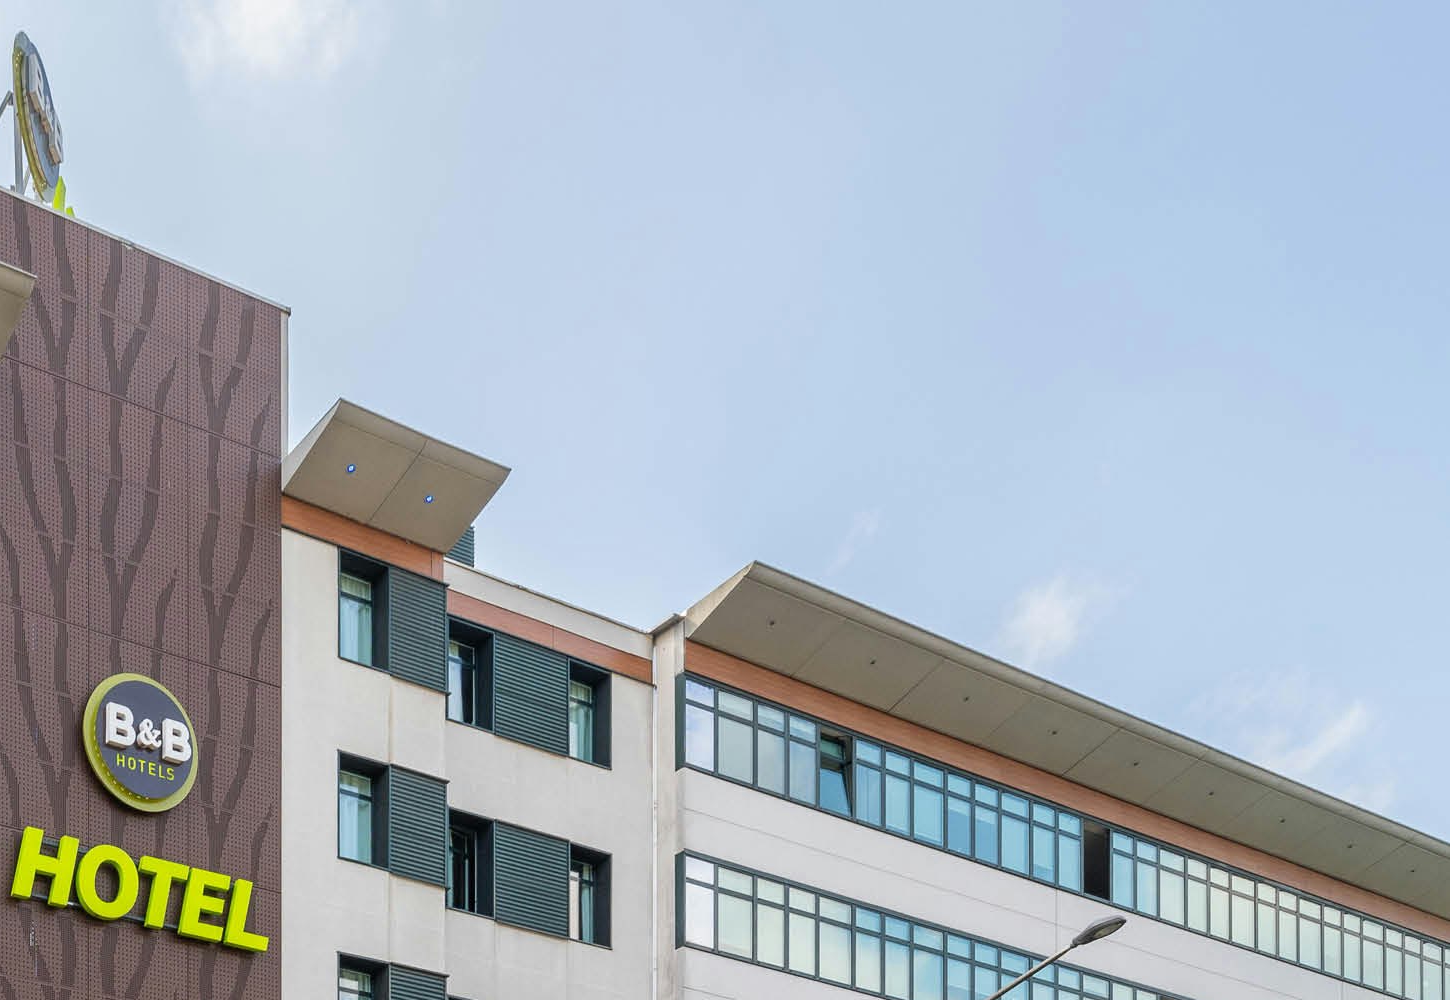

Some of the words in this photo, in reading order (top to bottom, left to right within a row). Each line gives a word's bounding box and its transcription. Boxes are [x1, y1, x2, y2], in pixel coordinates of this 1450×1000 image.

[105, 702, 192, 764] B&B
[116, 753, 175, 781] HOTELS
[11, 826, 269, 952] HOTEL
